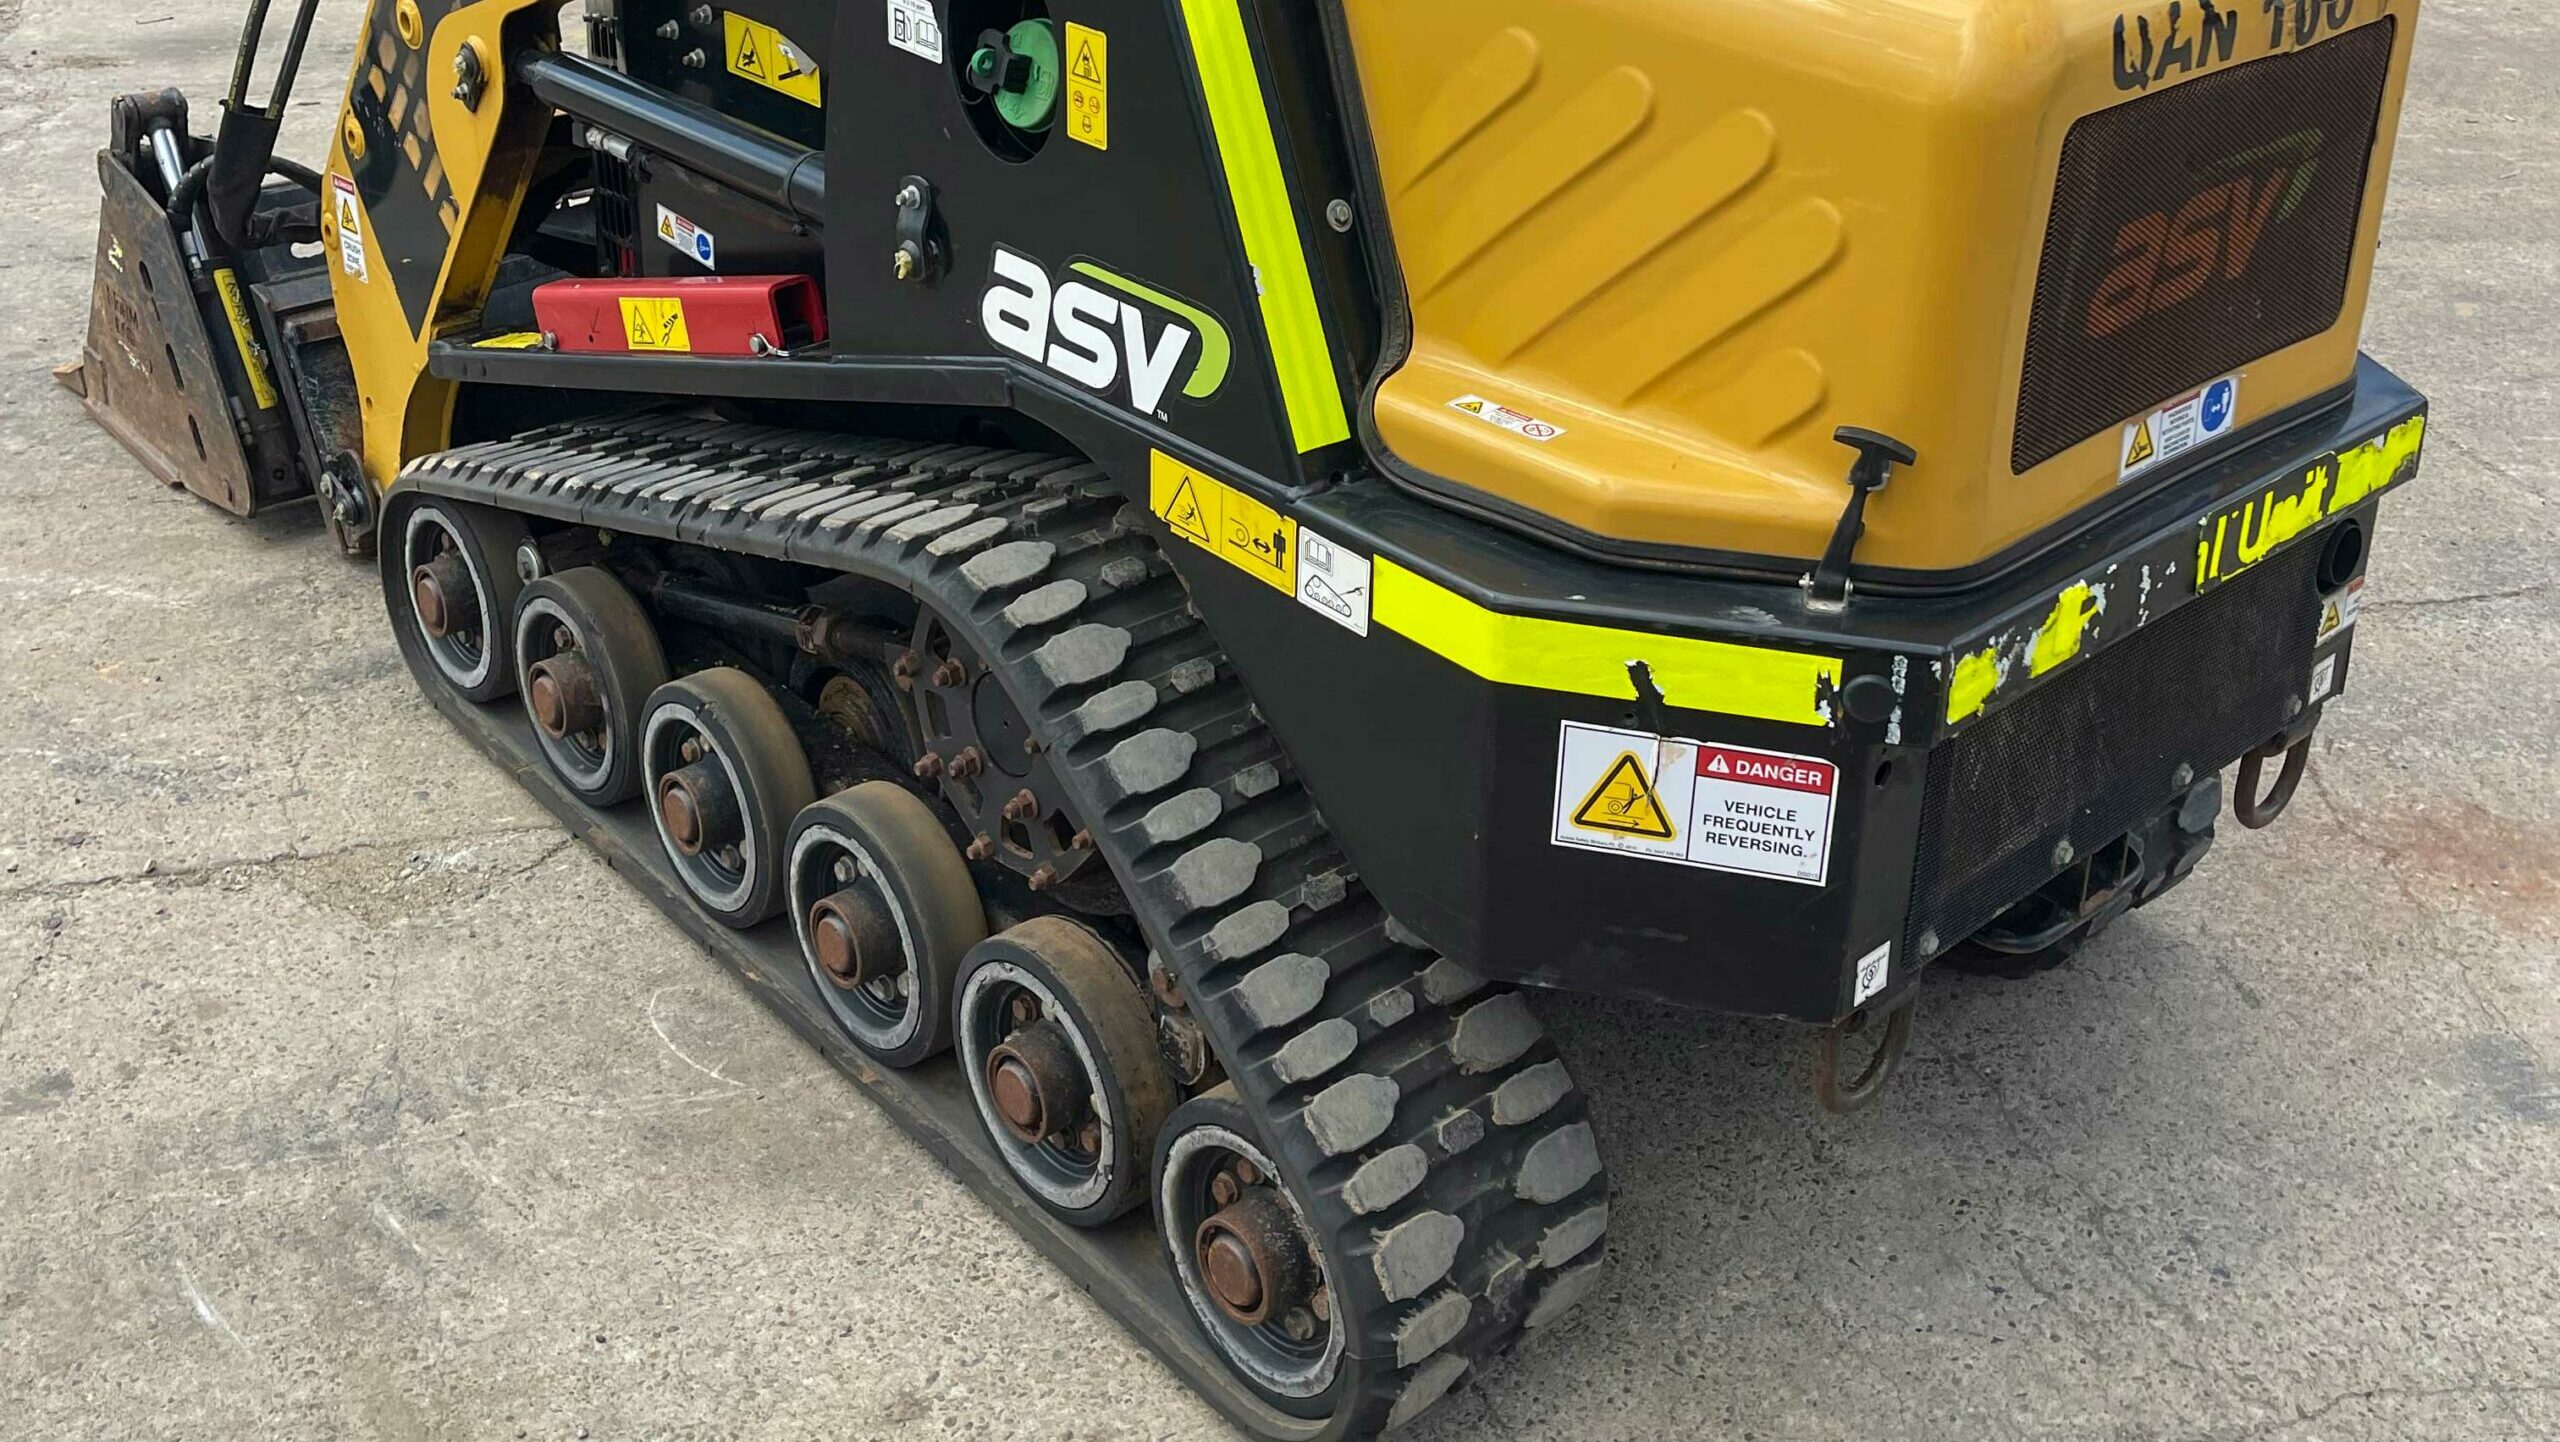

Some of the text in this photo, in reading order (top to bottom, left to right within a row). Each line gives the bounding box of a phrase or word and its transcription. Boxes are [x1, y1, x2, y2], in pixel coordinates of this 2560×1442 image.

[2082, 165, 2288, 339] asv
[982, 248, 1192, 415] asv
[1735, 759, 1823, 787] DANGER
[1724, 799, 1798, 823] VEHICLE
[1703, 813, 1816, 842] FREQUENTLY
[1705, 831, 1808, 858] REVERSING.
